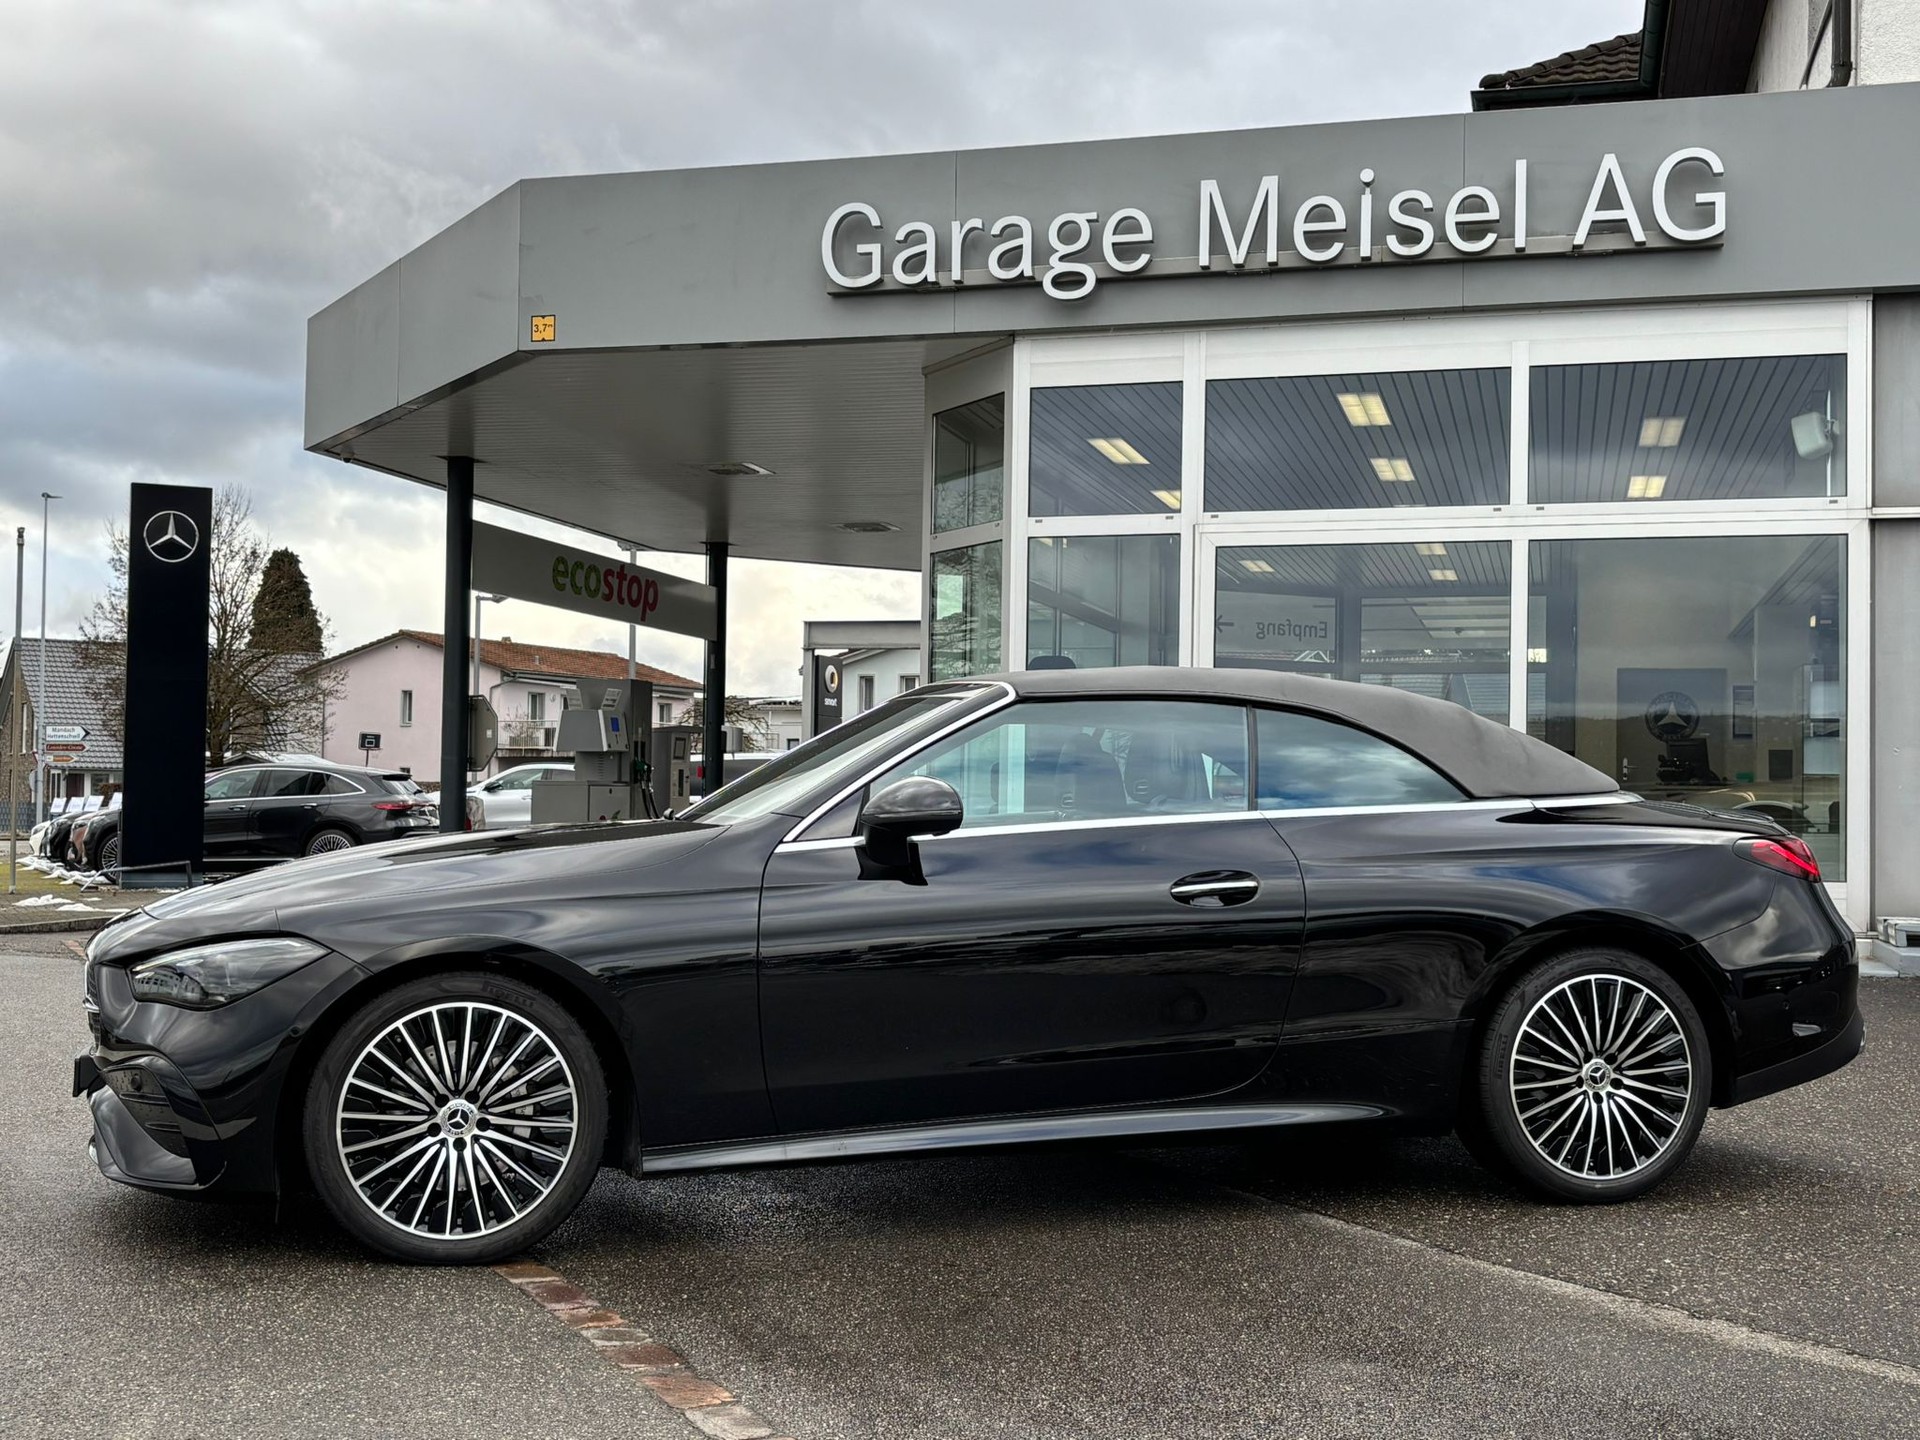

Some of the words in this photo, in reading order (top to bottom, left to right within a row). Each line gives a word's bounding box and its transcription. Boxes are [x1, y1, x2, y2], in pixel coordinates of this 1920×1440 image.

[821, 202, 1154, 300] Garage
[1199, 159, 1528, 270] Meisel
[1573, 147, 1727, 248] AG
[552, 555, 659, 622] ecostop
[824, 697, 838, 707] smart
